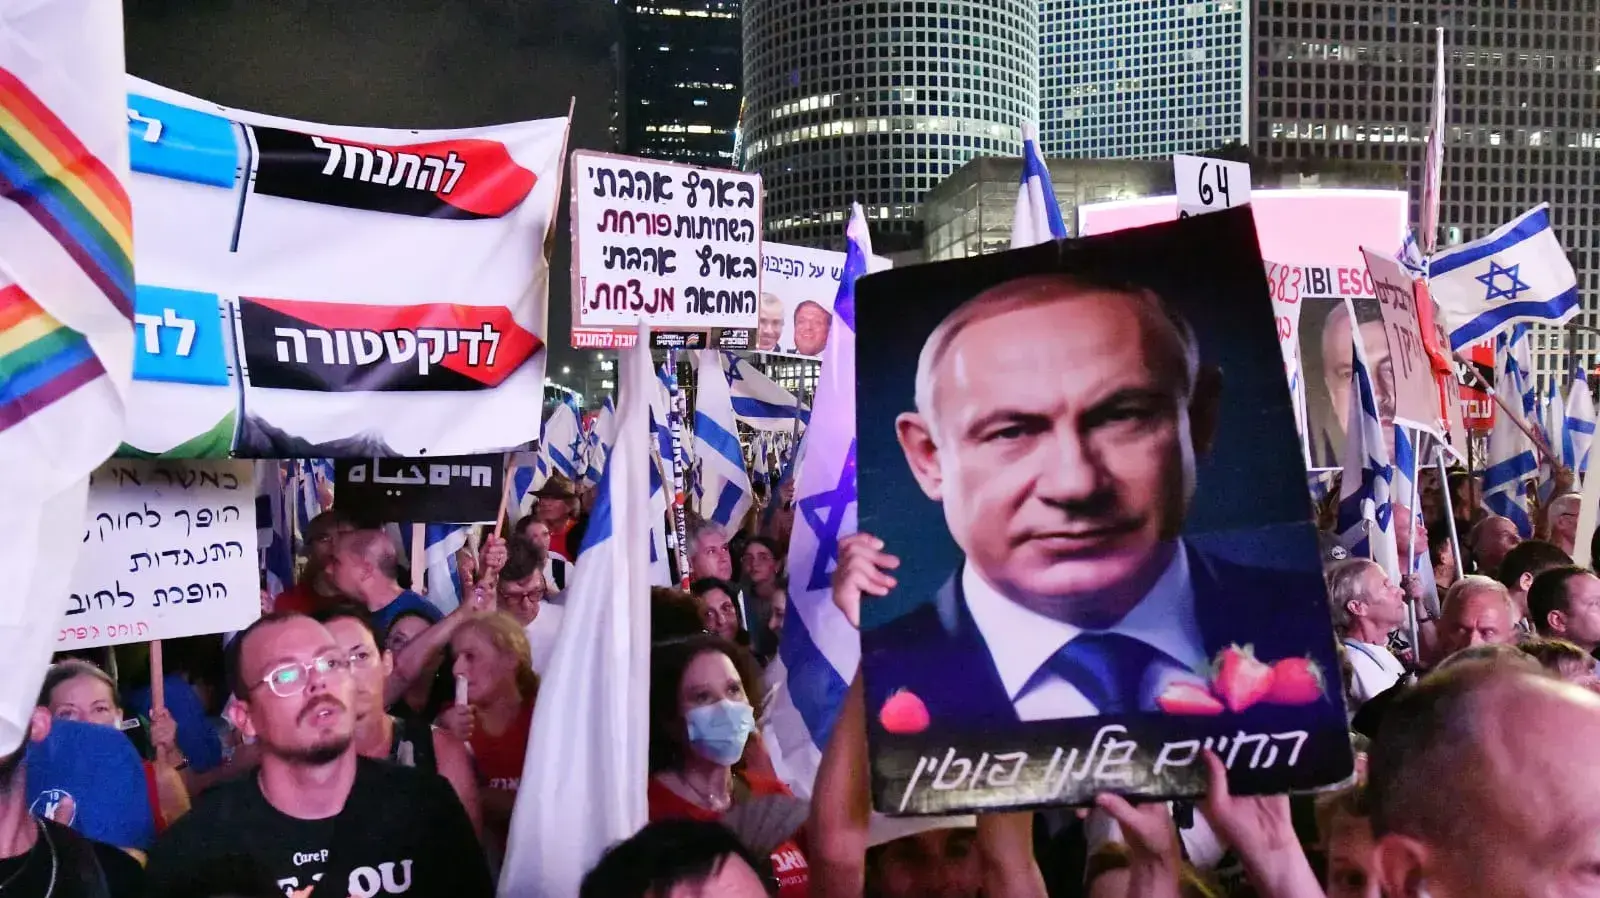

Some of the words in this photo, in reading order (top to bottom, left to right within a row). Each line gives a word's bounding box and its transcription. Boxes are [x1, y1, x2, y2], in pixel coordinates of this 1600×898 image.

[311, 136, 466, 195] להתנחל
[588, 166, 674, 203] אהבתי
[681, 170, 755, 209] בארץ
[1198, 162, 1230, 208] 64
[596, 208, 672, 237] פורחת
[674, 214, 755, 243] השחיתות
[602, 245, 677, 277] אהבתי
[695, 244, 757, 280] בארץ
[1303, 267, 1332, 295] IBI
[684, 286, 757, 315] המחאה
[274, 322, 501, 375] לדיקטטורה
[154, 467, 239, 490] כאשר
[429, 463, 492, 488] חיים
[174, 505, 240, 537] הופך
[129, 541, 243, 573] התנגדות
[152, 582, 228, 607] הופכת
[1152, 730, 1309, 775] החיים
[899, 747, 1029, 812] פוטין
[292, 851, 321, 866] Care
